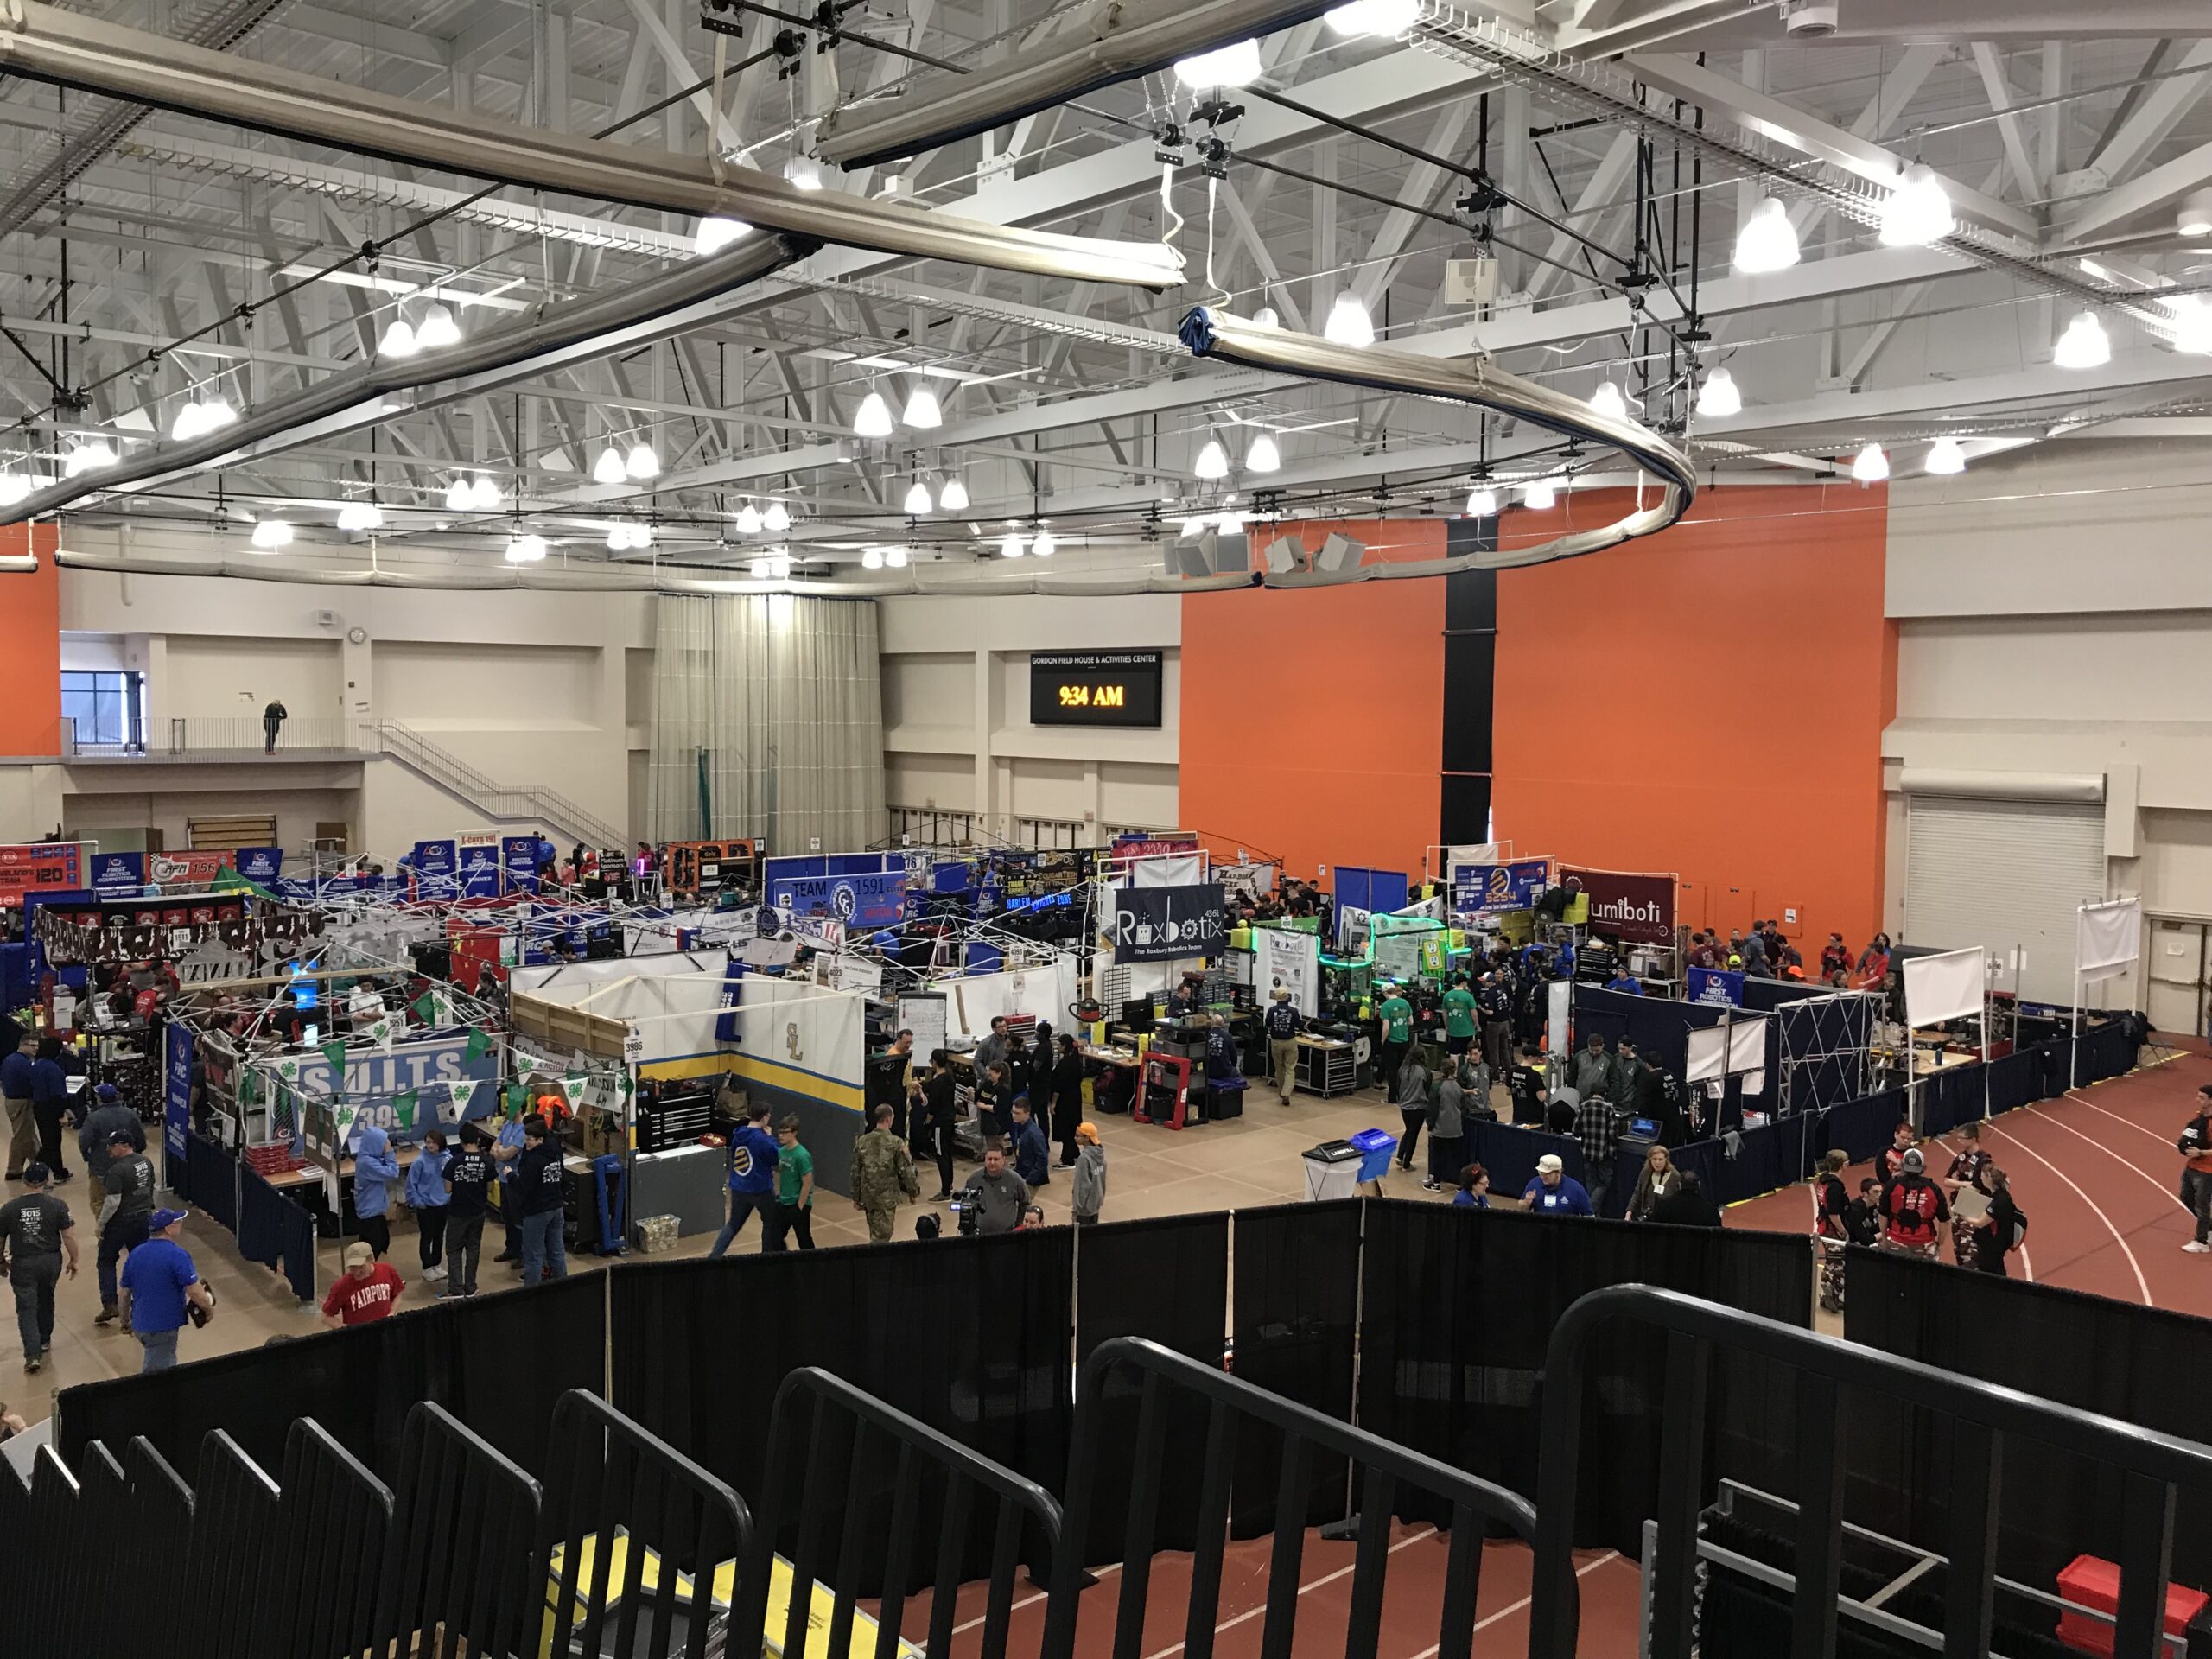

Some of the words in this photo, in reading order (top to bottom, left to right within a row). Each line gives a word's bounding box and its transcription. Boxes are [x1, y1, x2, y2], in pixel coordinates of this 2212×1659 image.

[1101, 655, 1132, 664] ACTIVITIES
[1059, 685, 1089, 706] 9:34
[1093, 685, 1123, 706] AM
[461, 836, 484, 845] X-CATS
[486, 835, 496, 844] 191
[193, 862, 215, 874] 156
[36, 867, 63, 883] 120
[792, 880, 827, 898] TEAM
[855, 878, 885, 895] 1591
[1007, 897, 1031, 910] HARLEM
[1057, 893, 1072, 906] ZONE
[1486, 891, 1517, 903] 5254
[1205, 909, 1220, 918] 4361
[175, 933, 188, 942] 1511
[830, 969, 842, 977] 4023
[1705, 987, 1726, 996] FIRST
[1699, 993, 1732, 1003] ROBOTICS
[626, 1041, 643, 1052] 3986
[21, 1210, 41, 1218] 3015
[350, 1283, 391, 1312] FAIRPORT
